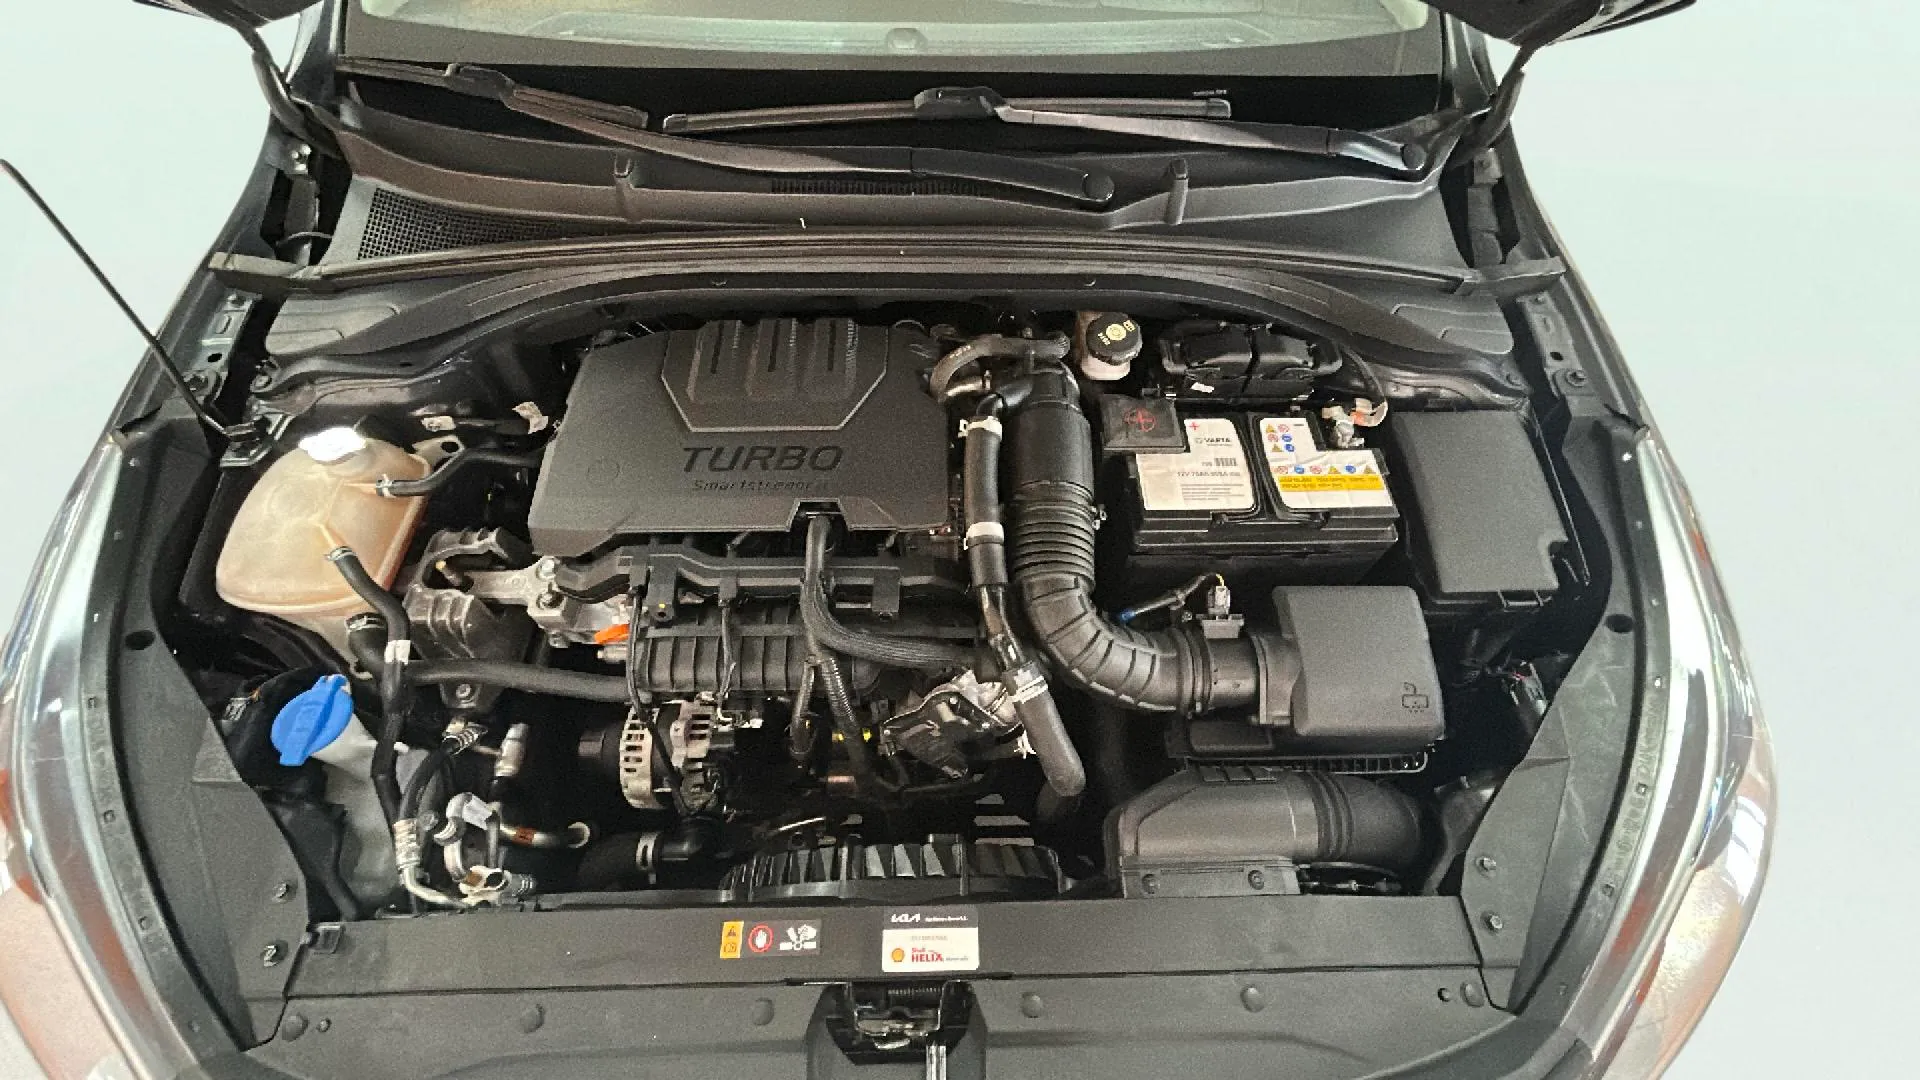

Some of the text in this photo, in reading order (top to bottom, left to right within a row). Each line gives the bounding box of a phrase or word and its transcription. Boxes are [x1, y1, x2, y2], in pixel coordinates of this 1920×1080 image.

[683, 445, 844, 473] TURBO
[891, 913, 921, 923] KIA
[911, 953, 943, 963] HELIX
